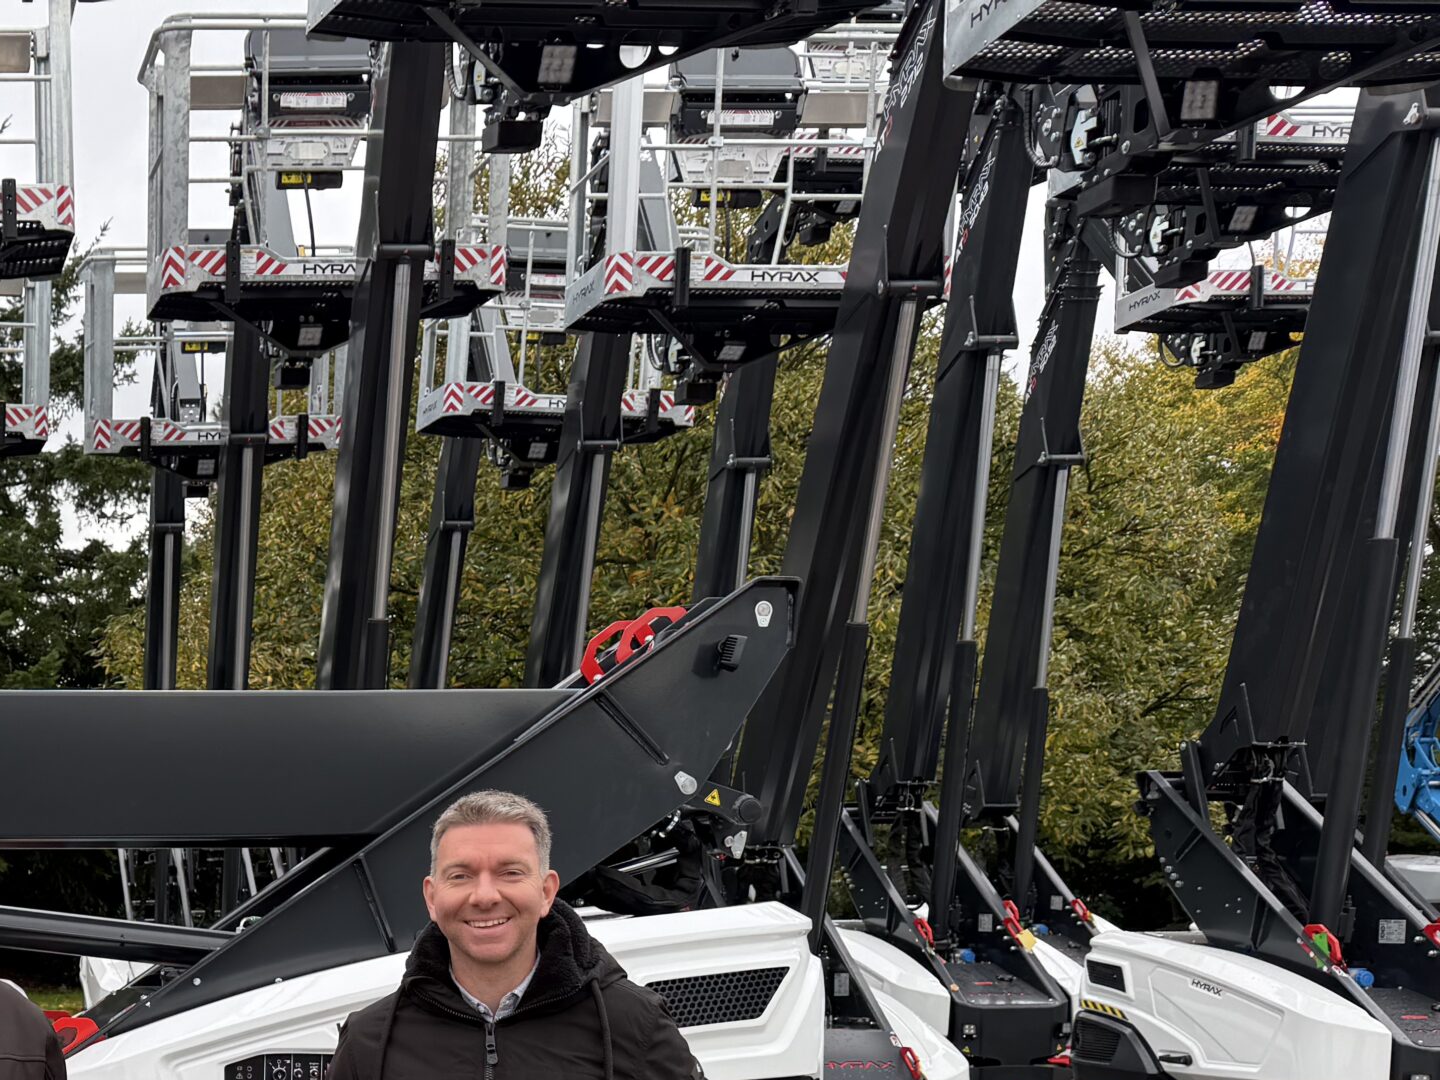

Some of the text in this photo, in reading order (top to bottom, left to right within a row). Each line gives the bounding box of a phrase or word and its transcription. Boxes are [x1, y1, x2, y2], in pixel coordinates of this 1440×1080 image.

[302, 263, 357, 274] HYRA
[751, 270, 820, 282] HYRAX
[1128, 289, 1162, 312] HYRAX
[1191, 978, 1223, 997] HYRAX
